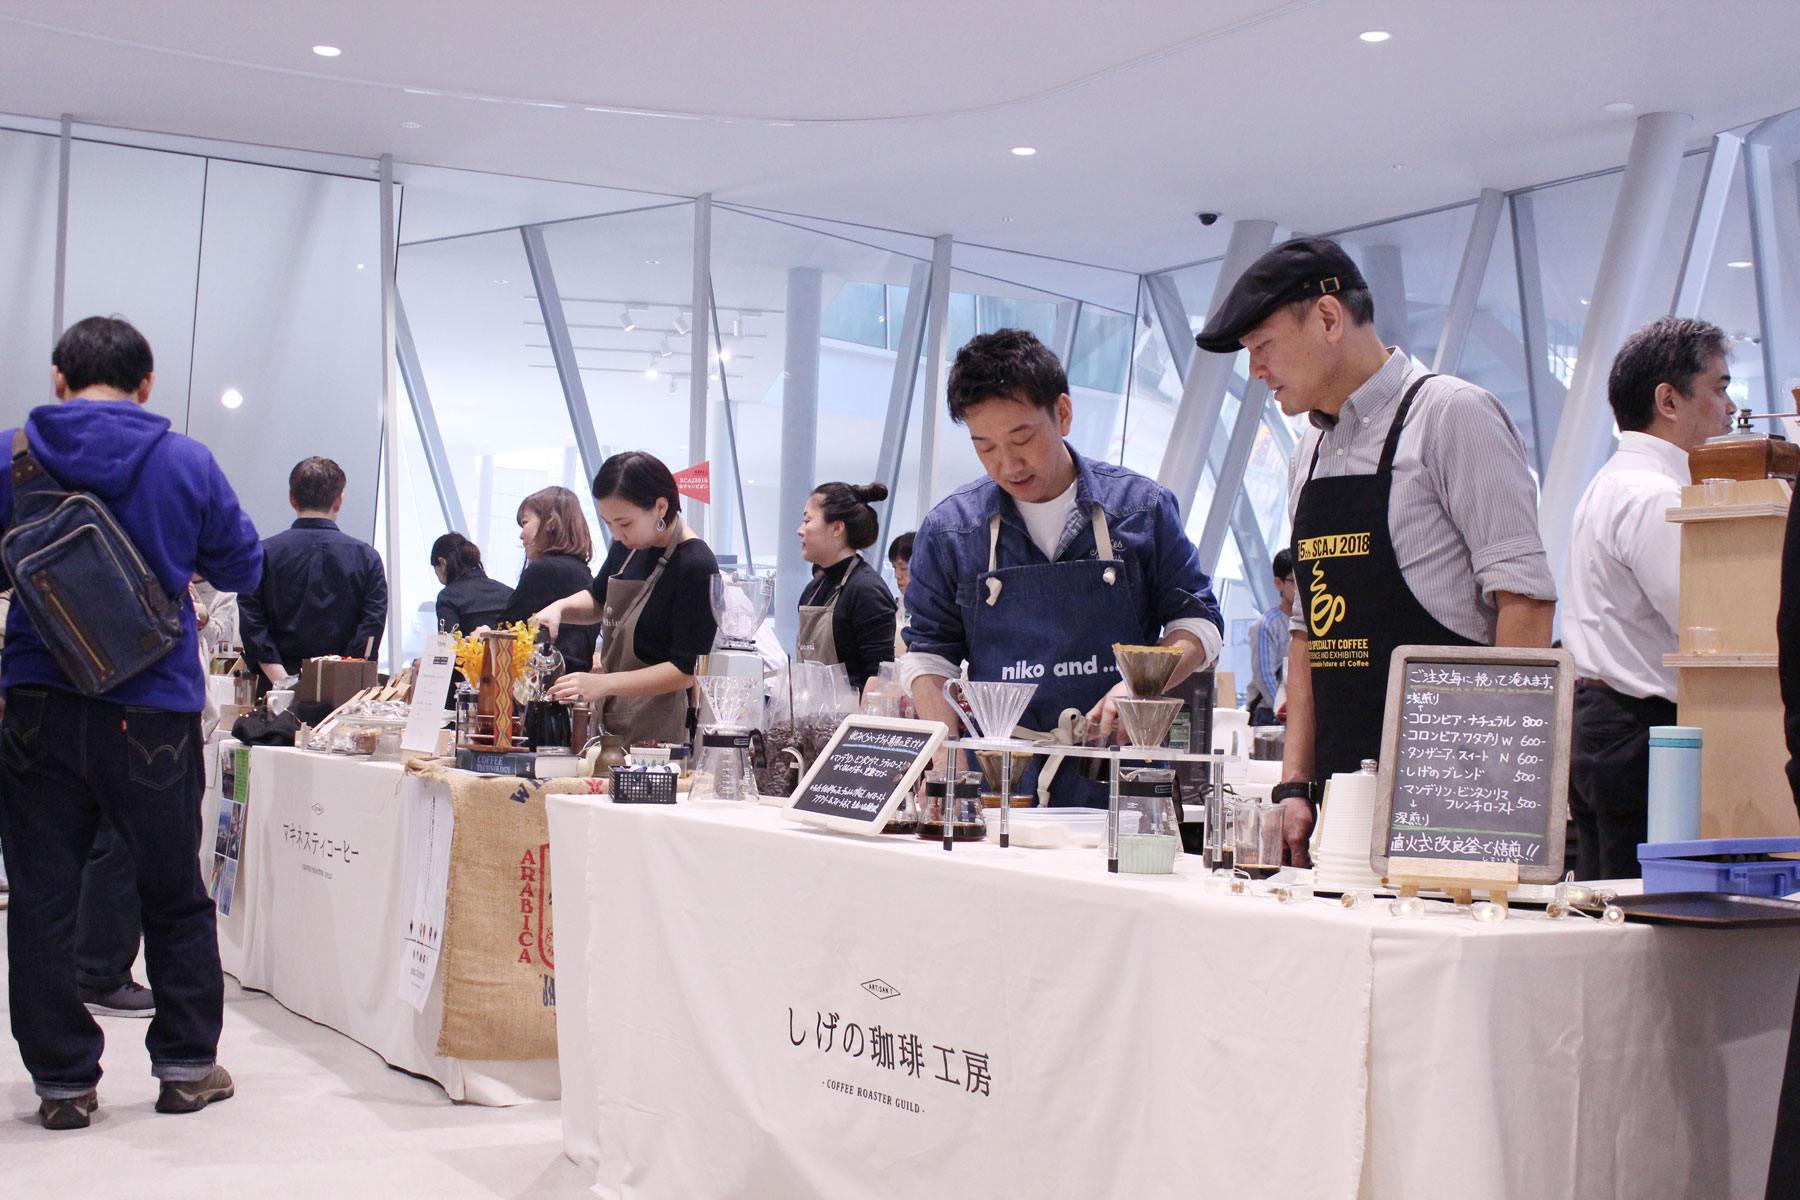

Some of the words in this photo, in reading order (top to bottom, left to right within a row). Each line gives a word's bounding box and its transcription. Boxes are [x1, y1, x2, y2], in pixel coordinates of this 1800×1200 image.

[1312, 538, 1338, 557] SCAJ
[1339, 535, 1369, 555] 2018
[1337, 639, 1369, 650] COFFEE
[1329, 651, 1369, 659] EXHIBITION
[1001, 660, 1045, 680] niko
[1053, 654, 1099, 677] and
[1347, 660, 1370, 668] Coffee
[1501, 736, 1514, 747] W
[477, 755, 504, 765] COFFEE
[1499, 752, 1510, 763] N
[476, 763, 512, 775] TECHNOLOGY
[1445, 799, 1515, 816] フレンチロースト
[282, 822, 360, 864] マキネスティコーヒー
[517, 849, 537, 964] ARABICA
[868, 983, 889, 994] ARTISAN
[788, 1006, 992, 1098] しげの珈琲工房
[826, 1079, 855, 1095] COFFEE
[857, 1087, 893, 1106] ROASTER
[895, 1098, 920, 1114] GUILD
